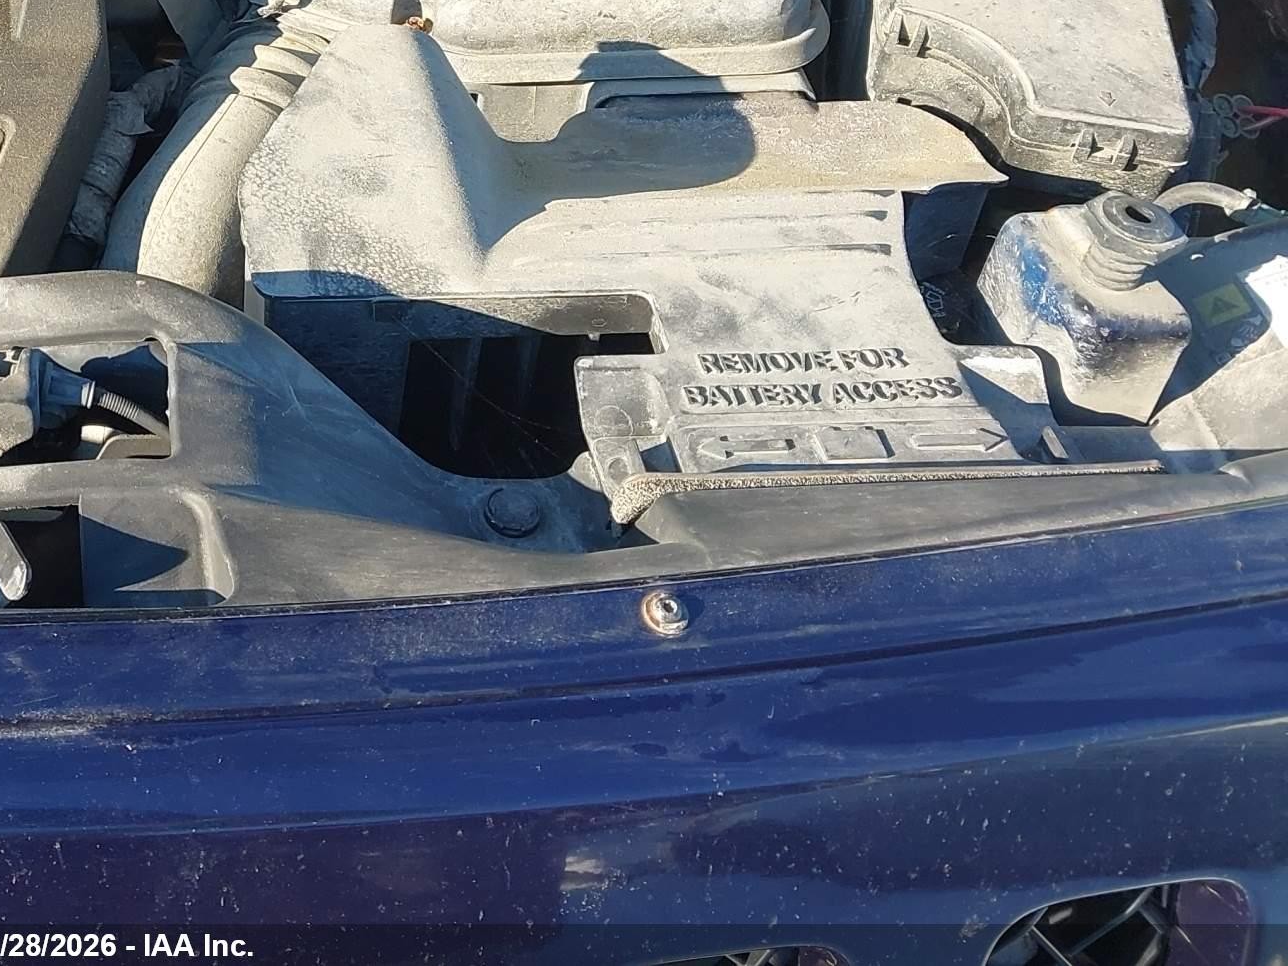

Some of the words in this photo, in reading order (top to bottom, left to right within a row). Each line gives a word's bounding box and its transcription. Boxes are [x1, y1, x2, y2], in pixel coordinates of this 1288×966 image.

[697, 350, 838, 374] REMOVE
[838, 347, 910, 370] FOR
[683, 383, 823, 408] BATTERY
[830, 376, 964, 405] ACCESS
